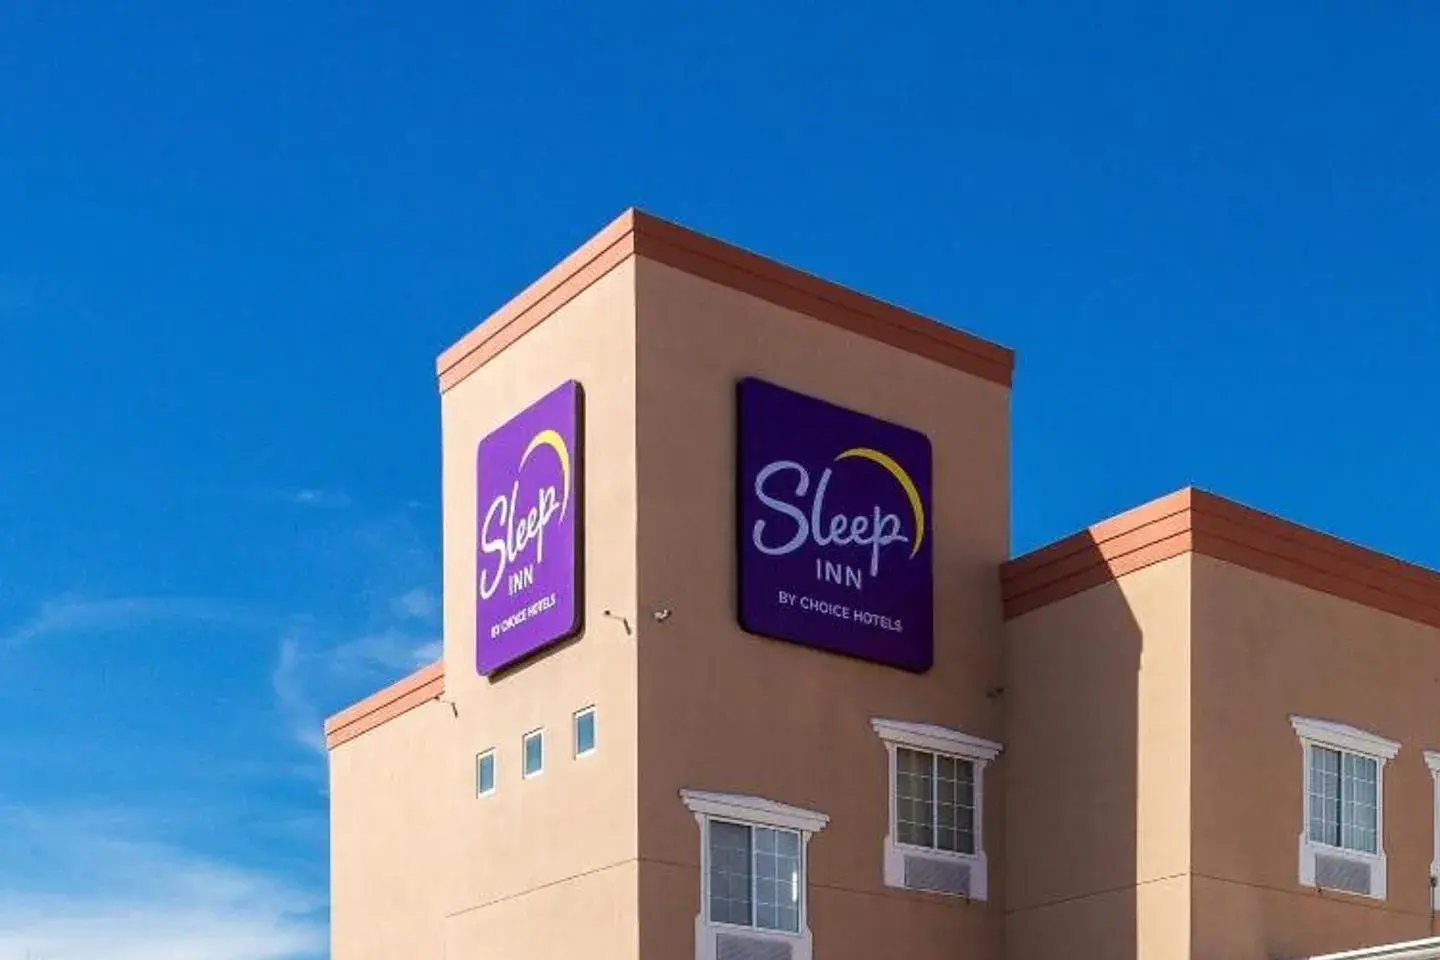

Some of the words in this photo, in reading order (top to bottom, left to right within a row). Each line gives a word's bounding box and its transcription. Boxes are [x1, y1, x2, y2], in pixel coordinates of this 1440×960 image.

[481, 479, 560, 600] Sleep
[753, 461, 909, 577] Sleep
[508, 564, 533, 595] INN
[816, 557, 861, 590] INN
[778, 590, 796, 606] BY
[800, 596, 850, 619] CHOICE
[854, 610, 903, 632] HOTELS
